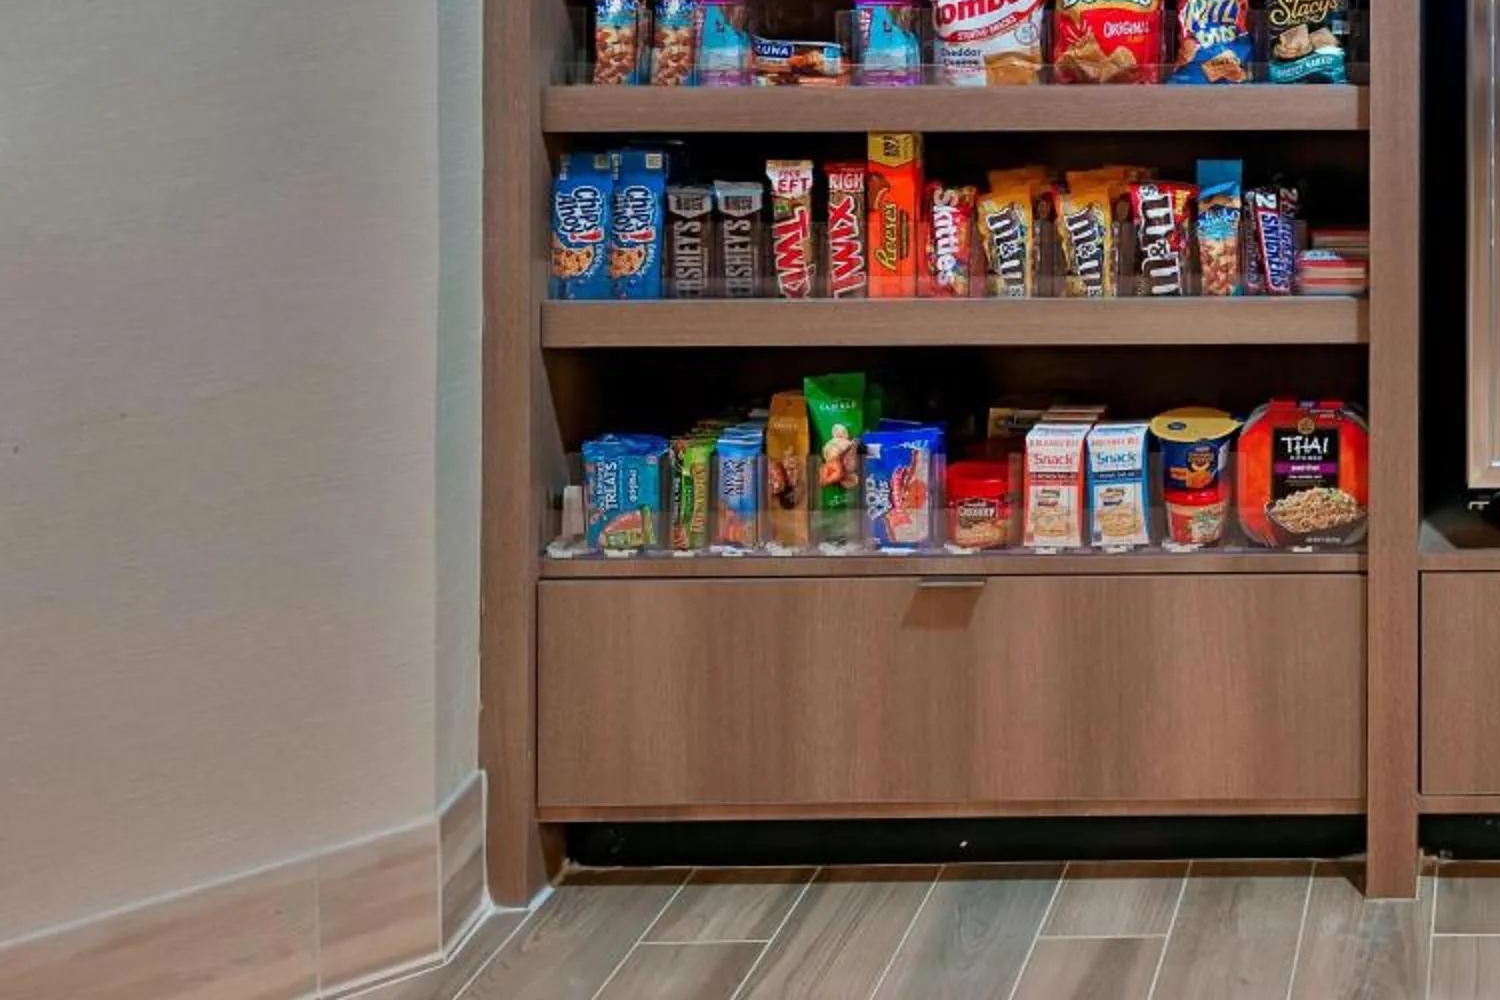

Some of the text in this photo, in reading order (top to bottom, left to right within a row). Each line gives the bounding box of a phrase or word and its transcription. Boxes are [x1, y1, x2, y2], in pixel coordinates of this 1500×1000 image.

[757, 44, 790, 57] UNA
[1281, 436, 1329, 455] THAI
[1033, 453, 1073, 465] Snack
[1096, 451, 1137, 466] Snack
[604, 461, 618, 510] TREATS
